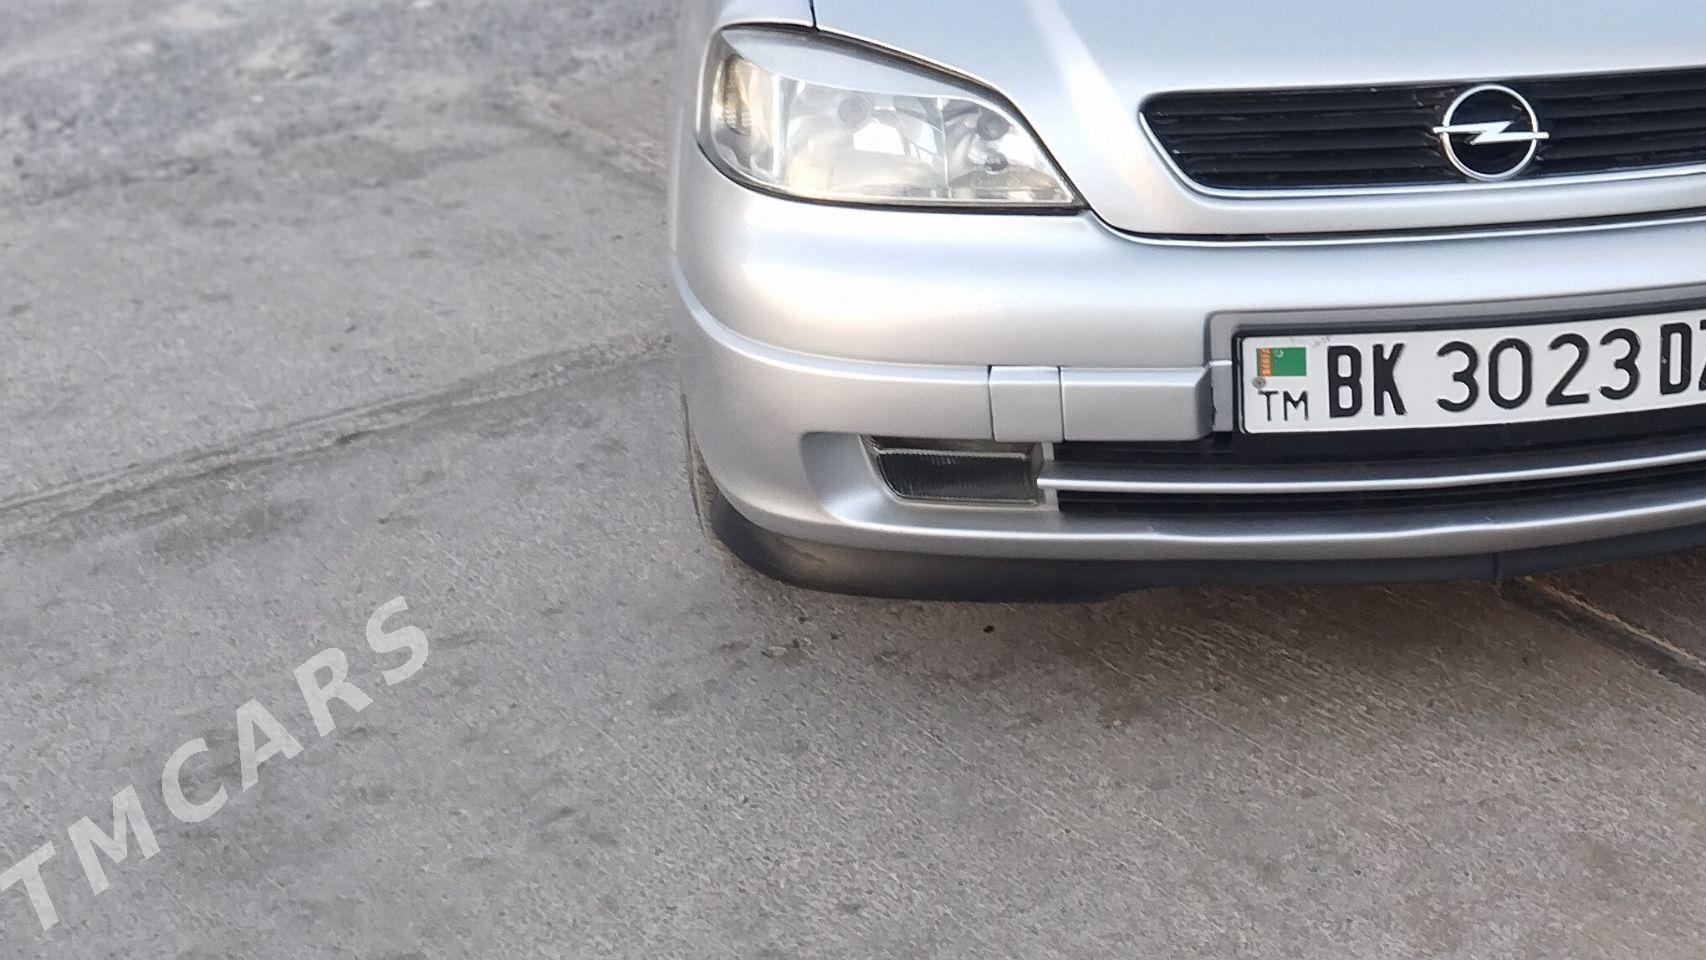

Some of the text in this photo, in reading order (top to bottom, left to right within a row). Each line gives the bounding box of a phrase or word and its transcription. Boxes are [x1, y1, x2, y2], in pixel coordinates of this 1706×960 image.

[1326, 343, 1407, 418] BK
[1435, 327, 1642, 413] 3023
[1258, 390, 1310, 422] TM
